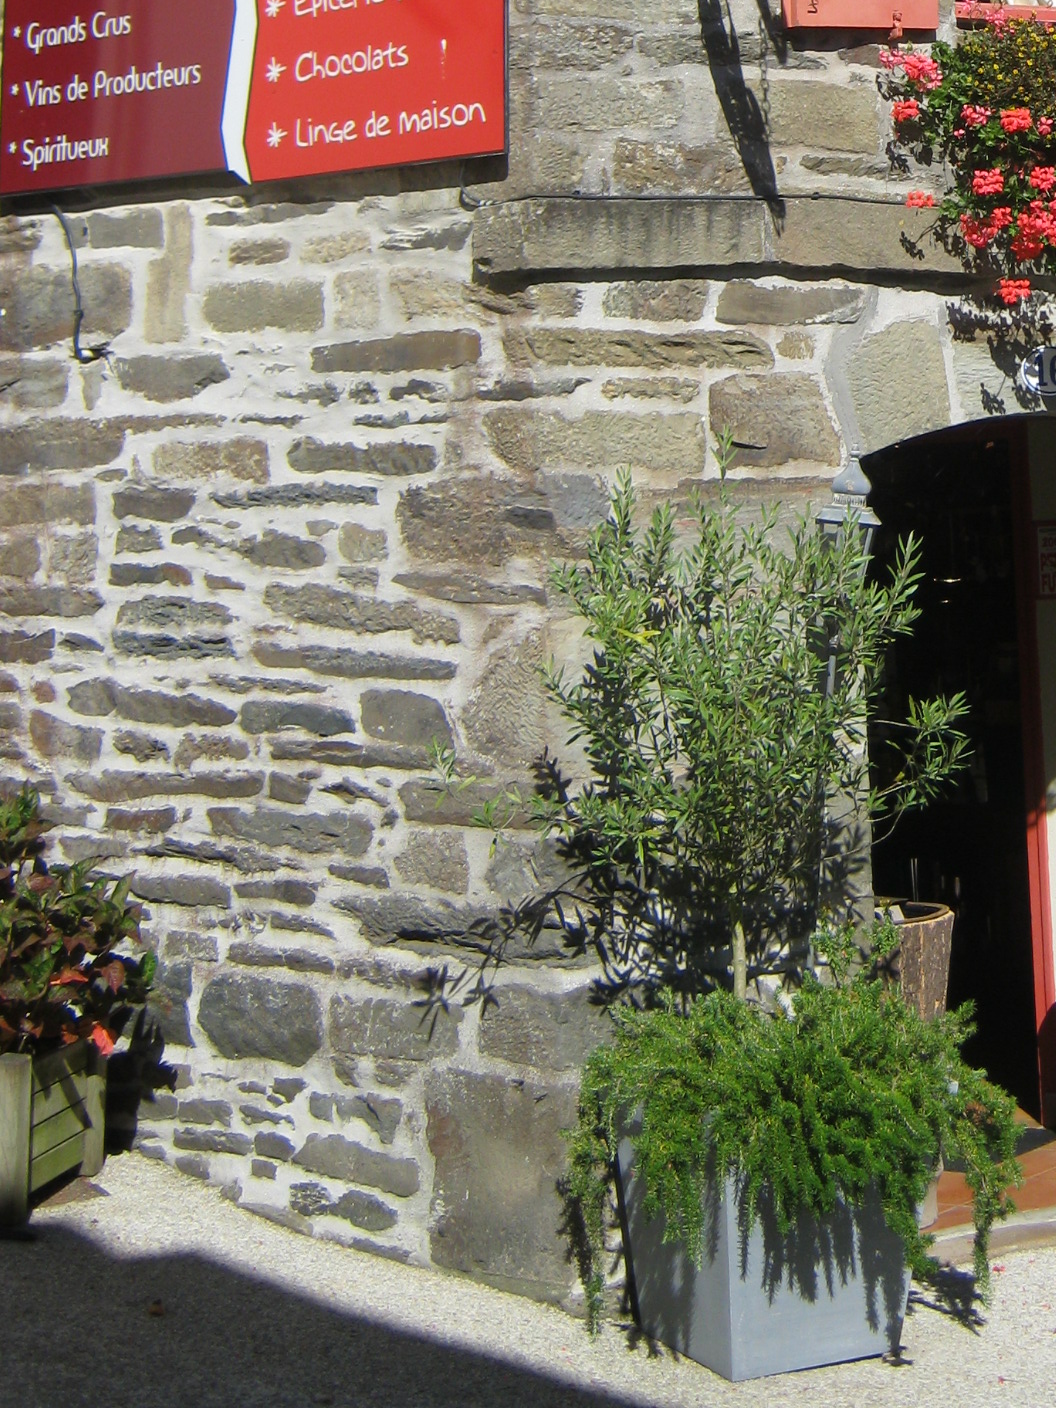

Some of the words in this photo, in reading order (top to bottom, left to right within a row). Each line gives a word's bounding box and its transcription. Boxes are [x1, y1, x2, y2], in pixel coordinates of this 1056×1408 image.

[26, 14, 88, 55] Grands
[92, 11, 132, 39] Crus
[294, 41, 410, 83] Chocolats
[25, 79, 62, 107] Vins
[66, 73, 89, 102] de
[93, 61, 202, 99] Producteurs
[365, 110, 392, 139] de
[21, 133, 110, 172] Spiritueux
